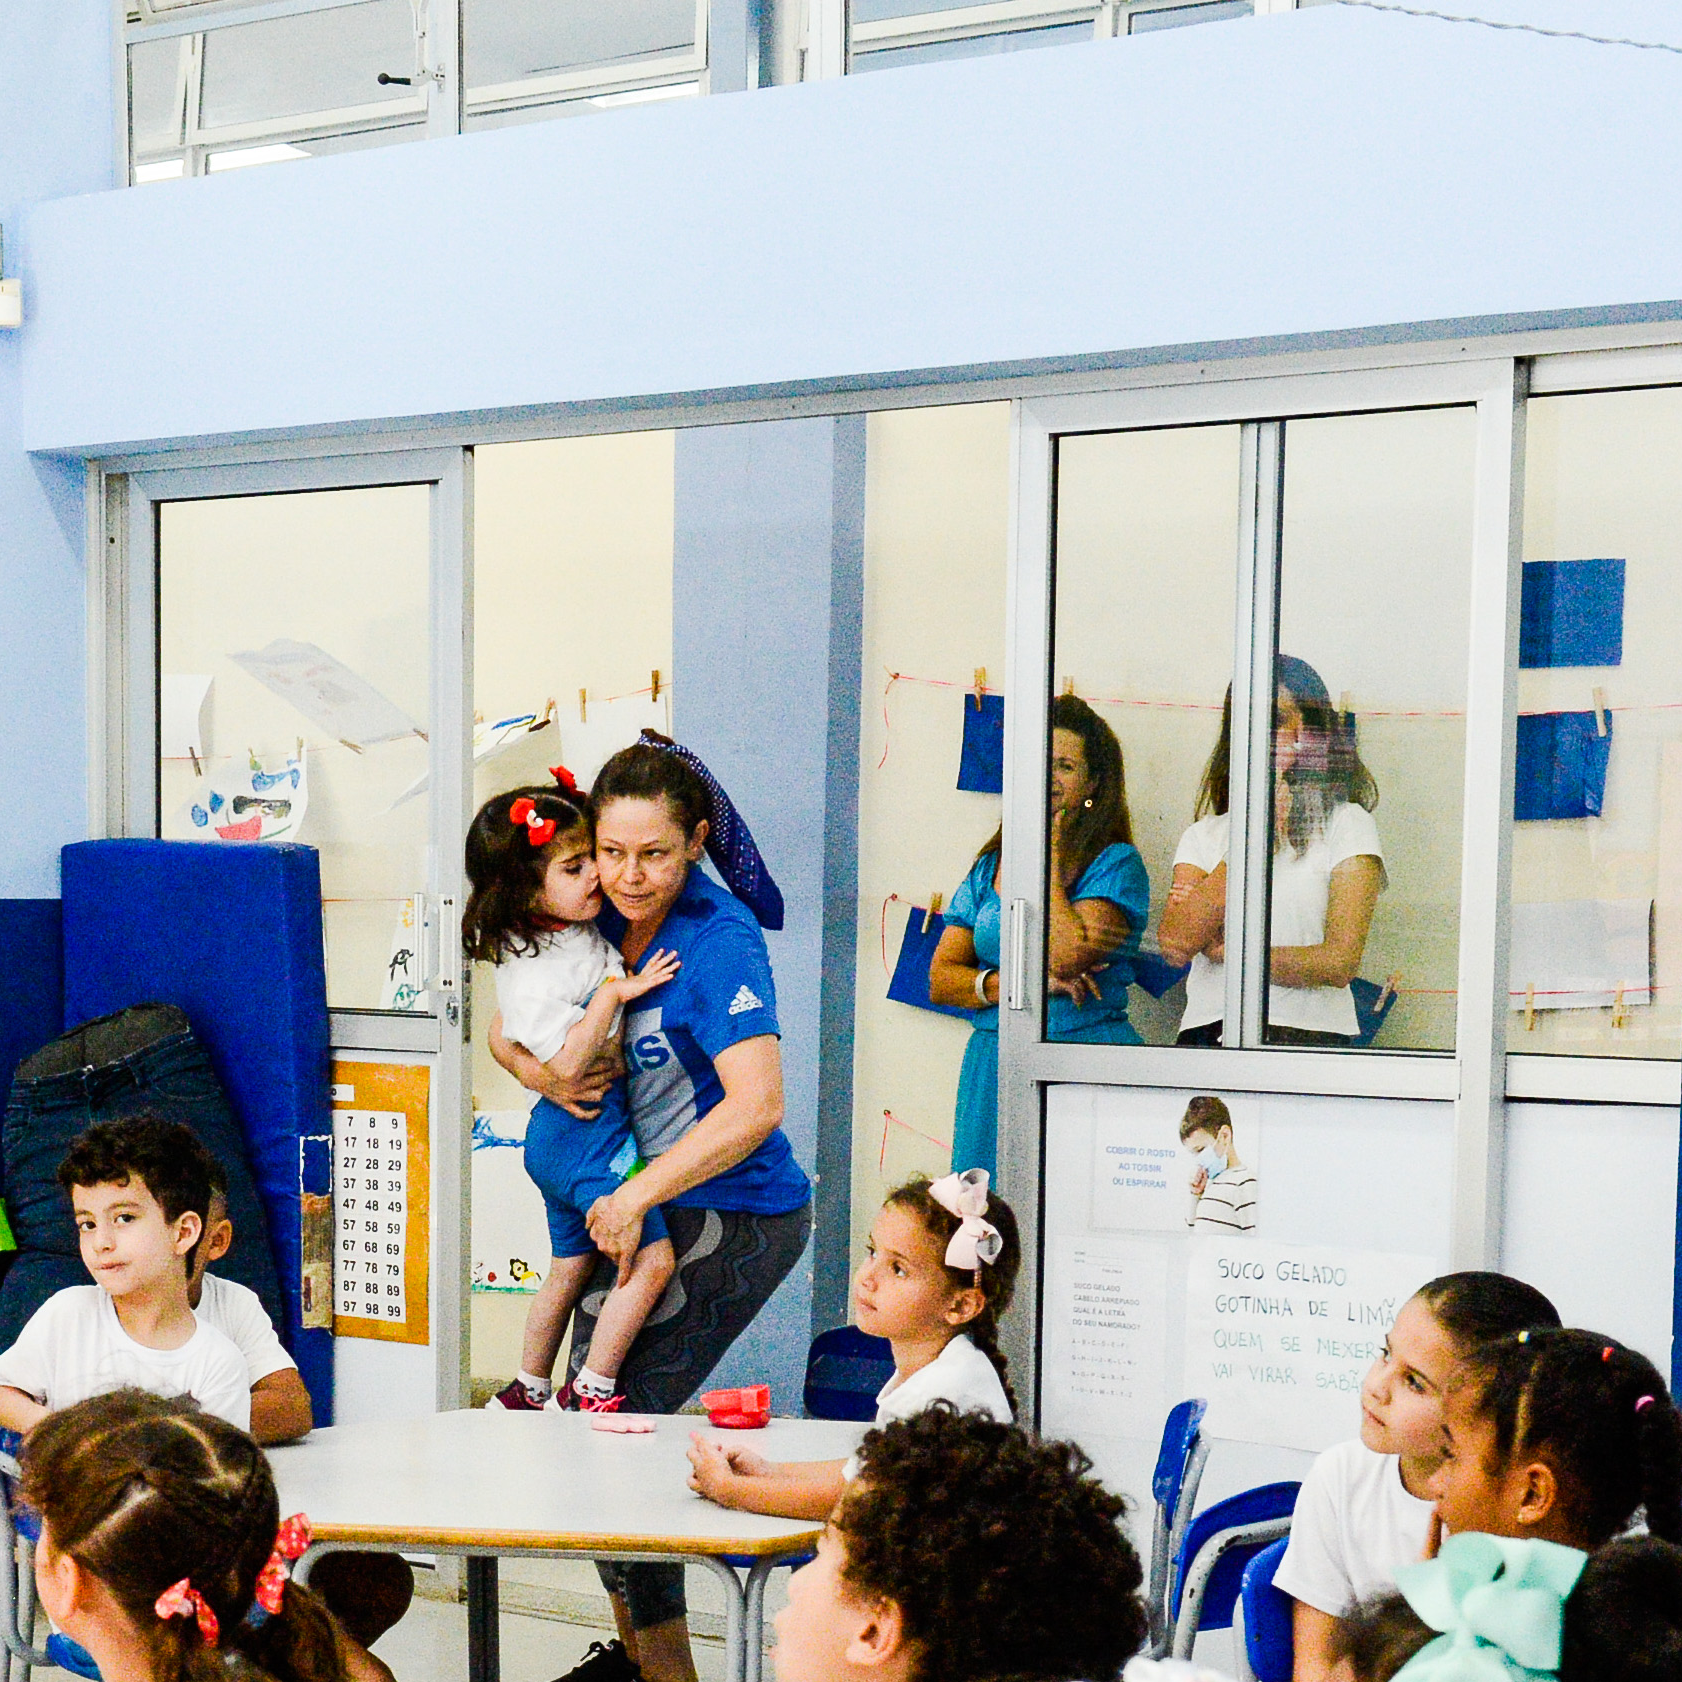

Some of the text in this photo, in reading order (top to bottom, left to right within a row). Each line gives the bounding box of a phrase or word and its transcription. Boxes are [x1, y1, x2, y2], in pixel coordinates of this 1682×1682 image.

[347, 1116, 398, 1129] 7 8 9
[344, 1136, 402, 1150] 17 18 19
[343, 1157, 402, 1171] 27 28 29
[343, 1178, 401, 1192] 37 38 39
[342, 1198, 402, 1213] 47 48 49
[343, 1219, 400, 1234] 57 58 59
[342, 1239, 400, 1255] 67 68 69
[342, 1260, 400, 1276] 77 78 79
[1218, 1258, 1347, 1286] SUCO GELADO
[343, 1280, 400, 1296] 87 88 89
[343, 1300, 401, 1317] 97 98 99
[1215, 1294, 1396, 1326] GOTINHA DE LIMÃ
[1213, 1329, 1379, 1360] QUEM SE MEXER
[1212, 1363, 1361, 1393] VAI VIRAR SABÃ
